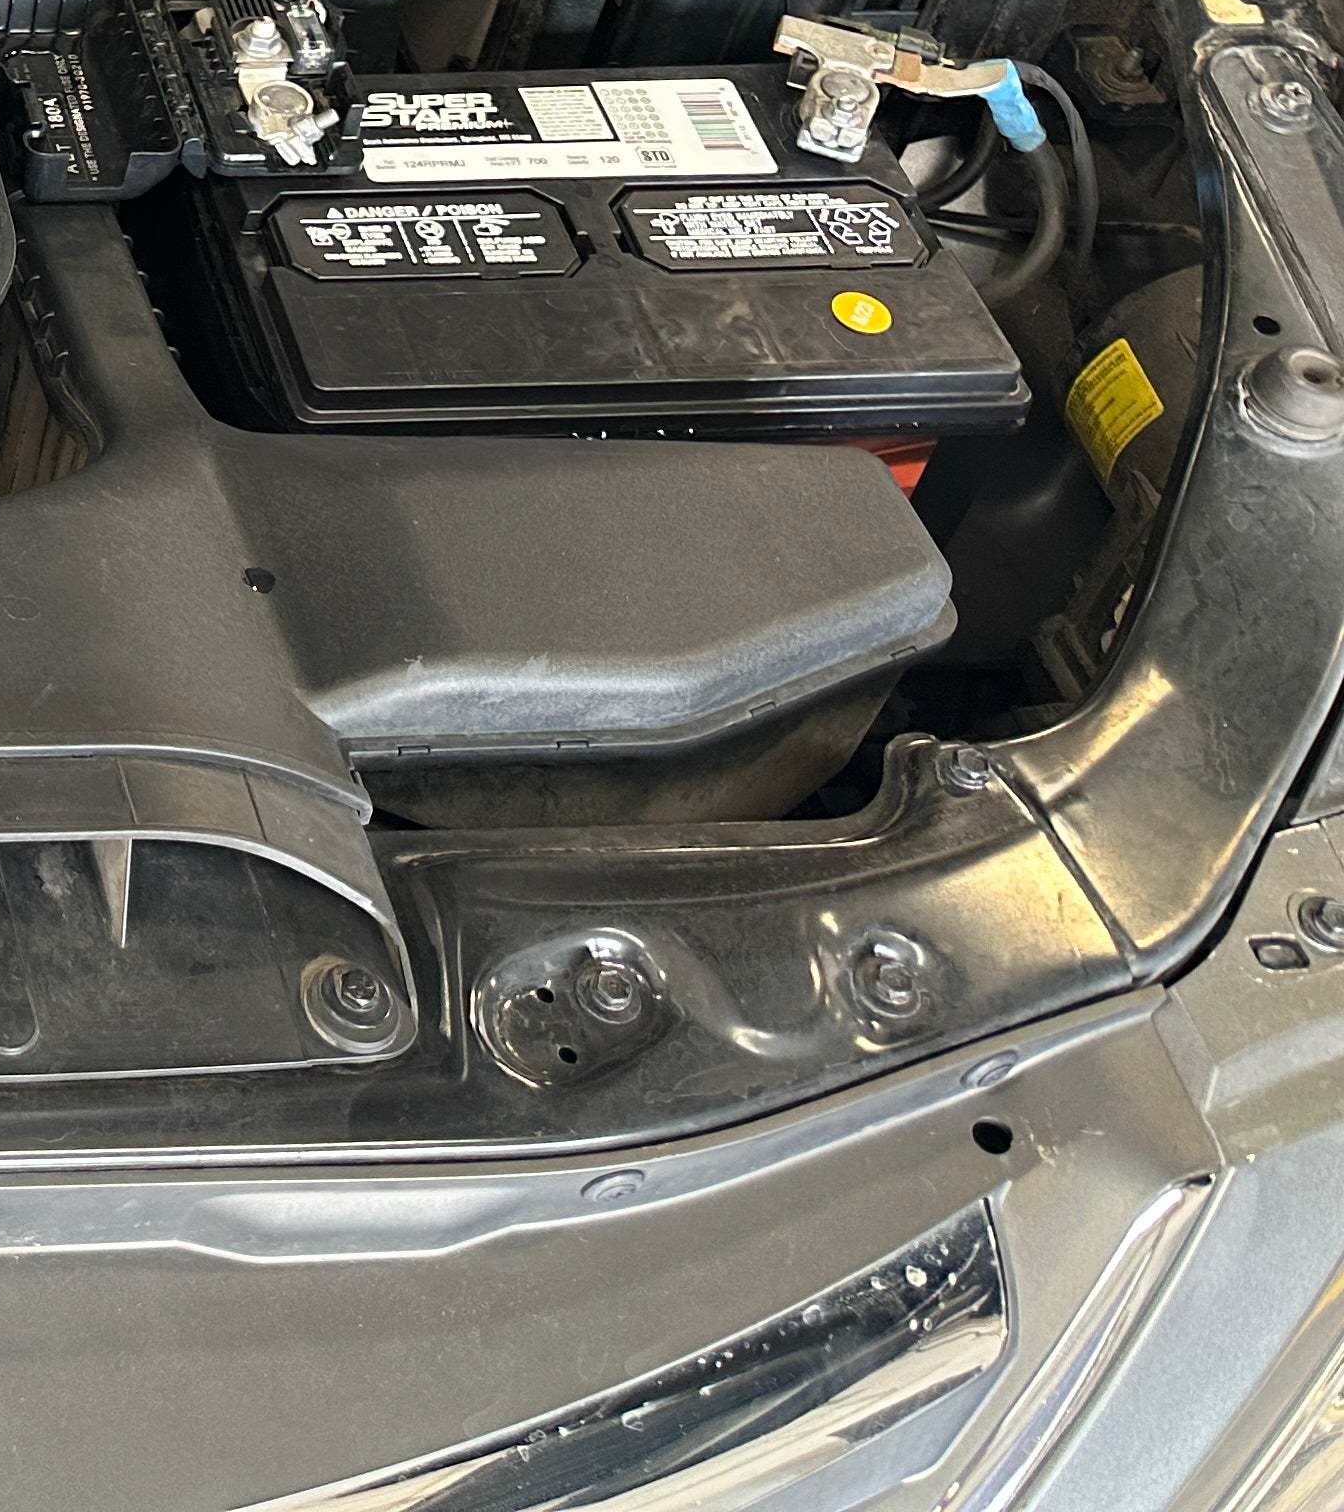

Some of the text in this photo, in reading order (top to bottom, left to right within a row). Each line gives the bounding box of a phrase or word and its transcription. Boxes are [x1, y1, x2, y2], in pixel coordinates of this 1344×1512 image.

[53, 54, 69, 75] ONLY
[368, 92, 492, 110] SUPER
[42, 97, 67, 130] 180A
[66, 94, 90, 142] DESIGNATED
[360, 107, 498, 128] START
[81, 143, 95, 158] THE
[526, 157, 549, 166] 700
[599, 155, 621, 165] 120
[343, 205, 419, 219] DANGER
[435, 204, 505, 217] POISON
